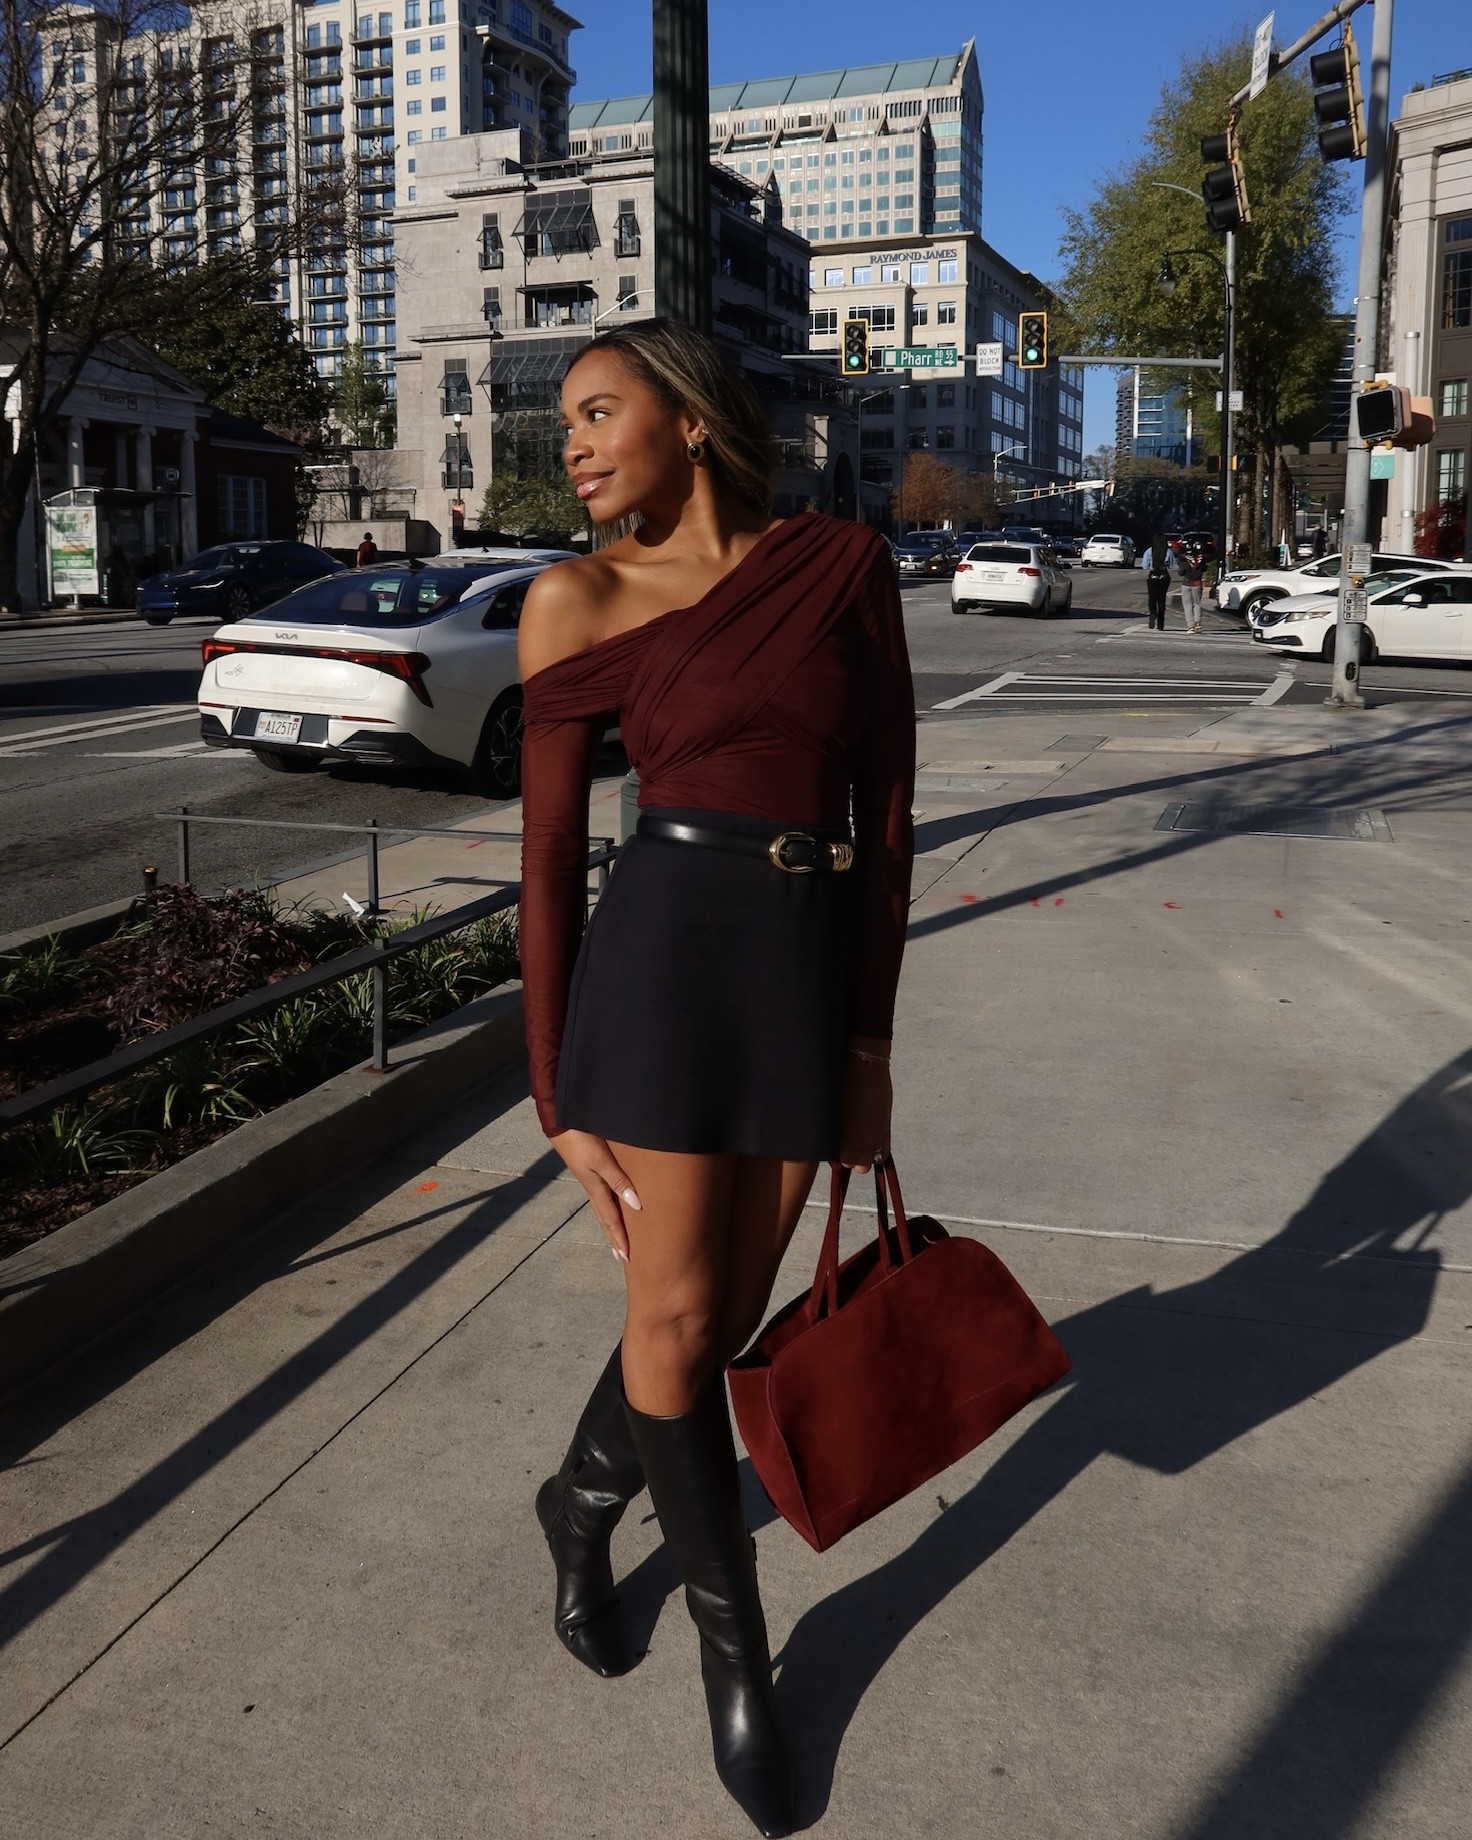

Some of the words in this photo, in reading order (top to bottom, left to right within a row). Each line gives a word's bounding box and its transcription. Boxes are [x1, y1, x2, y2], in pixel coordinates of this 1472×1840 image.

[870, 252, 922, 264] RAYMOND
[923, 249, 957, 260] JAMES
[979, 348, 987, 356] DO
[990, 347, 1000, 356] NOT
[901, 350, 932, 366] Pharr
[935, 350, 943, 359] RD
[935, 359, 943, 367] NE
[980, 357, 999, 365] BLOCK
[98, 393, 126, 405] TRUIST
[265, 720, 298, 736] A125TP
